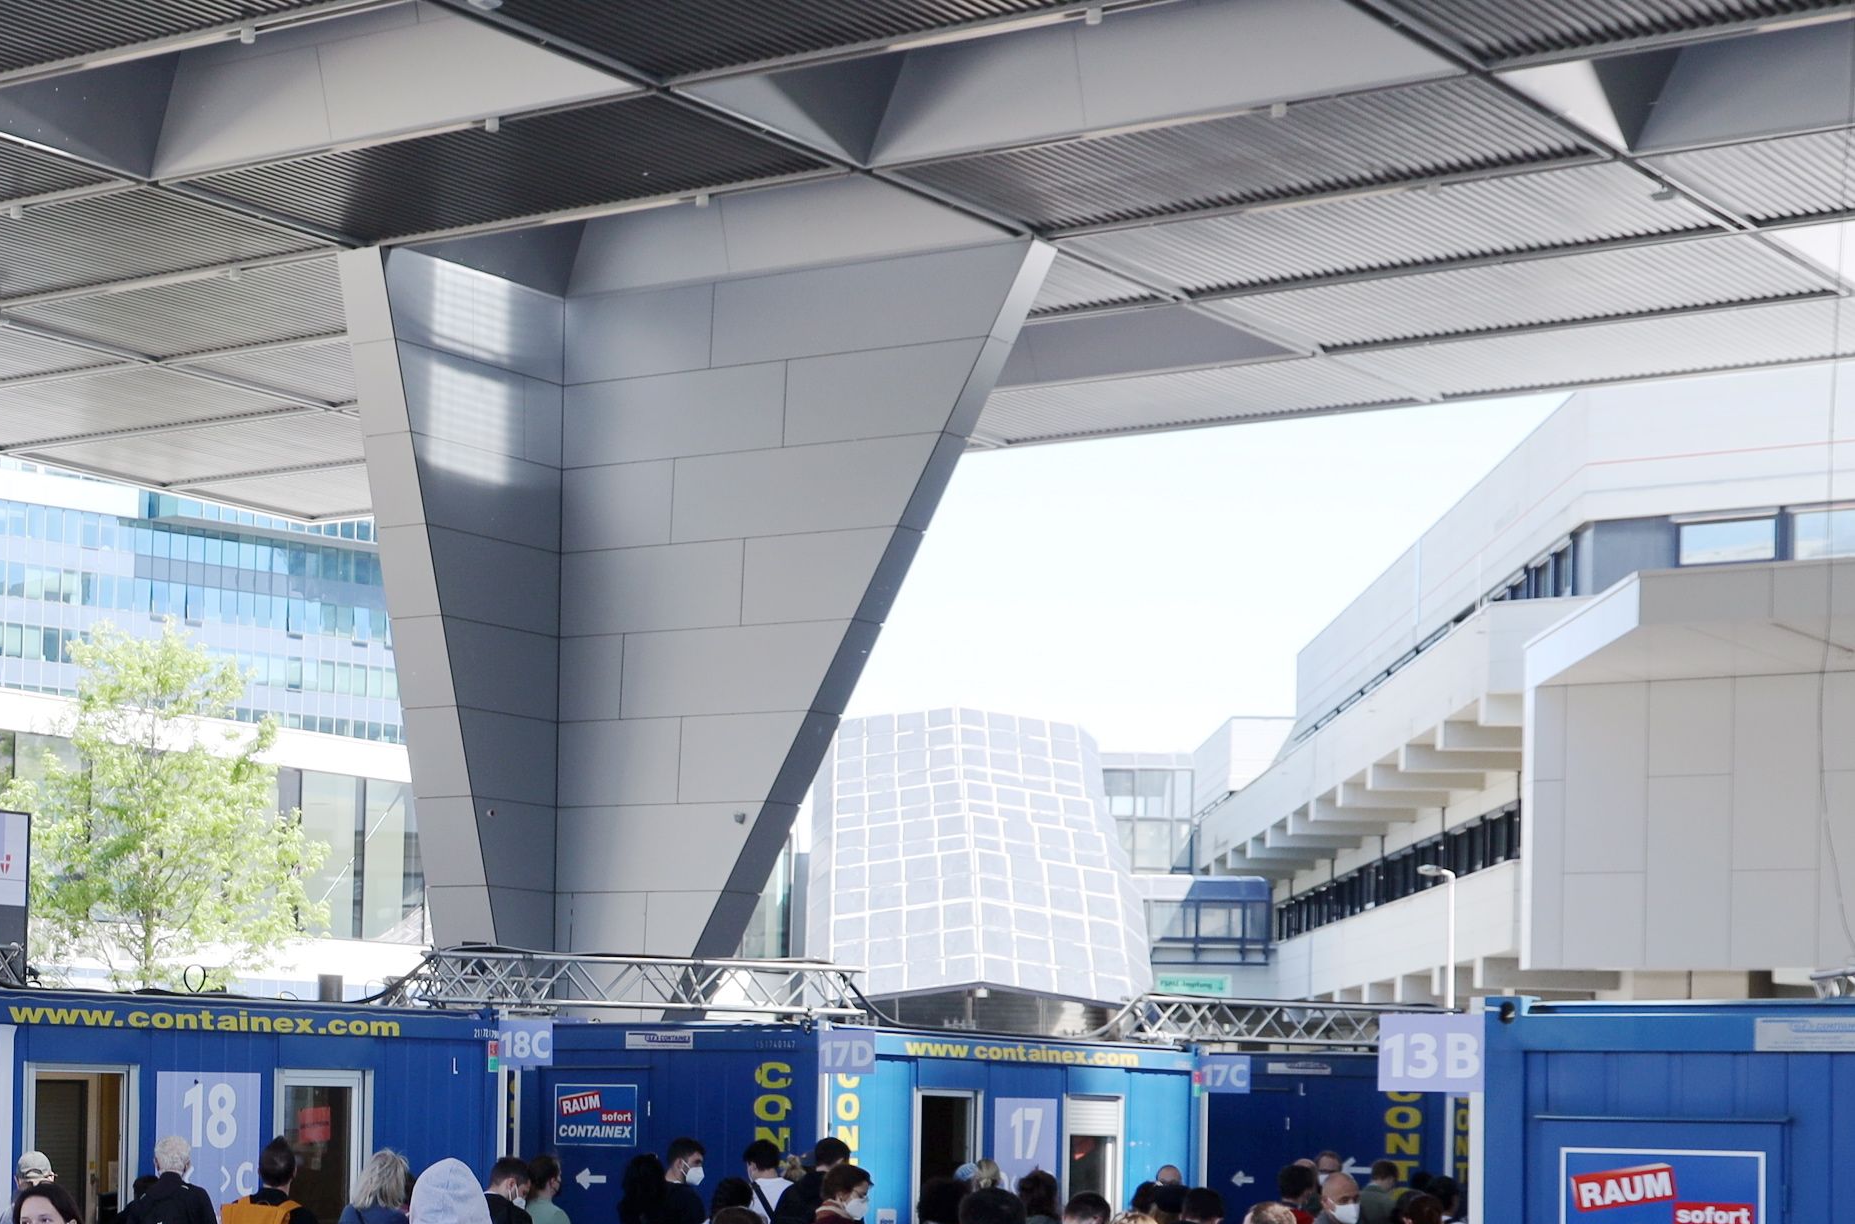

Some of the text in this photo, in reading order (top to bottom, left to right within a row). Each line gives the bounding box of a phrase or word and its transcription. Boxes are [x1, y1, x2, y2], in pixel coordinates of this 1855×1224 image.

[8, 1005, 401, 1037] www.containex.com
[500, 1030, 550, 1059] 18C
[820, 1040, 874, 1067] 17D
[1203, 1063, 1248, 1088] 17C
[183, 1082, 238, 1149] 18
[561, 1095, 601, 1115] RAUM
[601, 1111, 632, 1122] sofort
[558, 1124, 632, 1139] CONTAINEX
[1010, 1107, 1043, 1160] 17
[1578, 1171, 1674, 1208] RAUM
